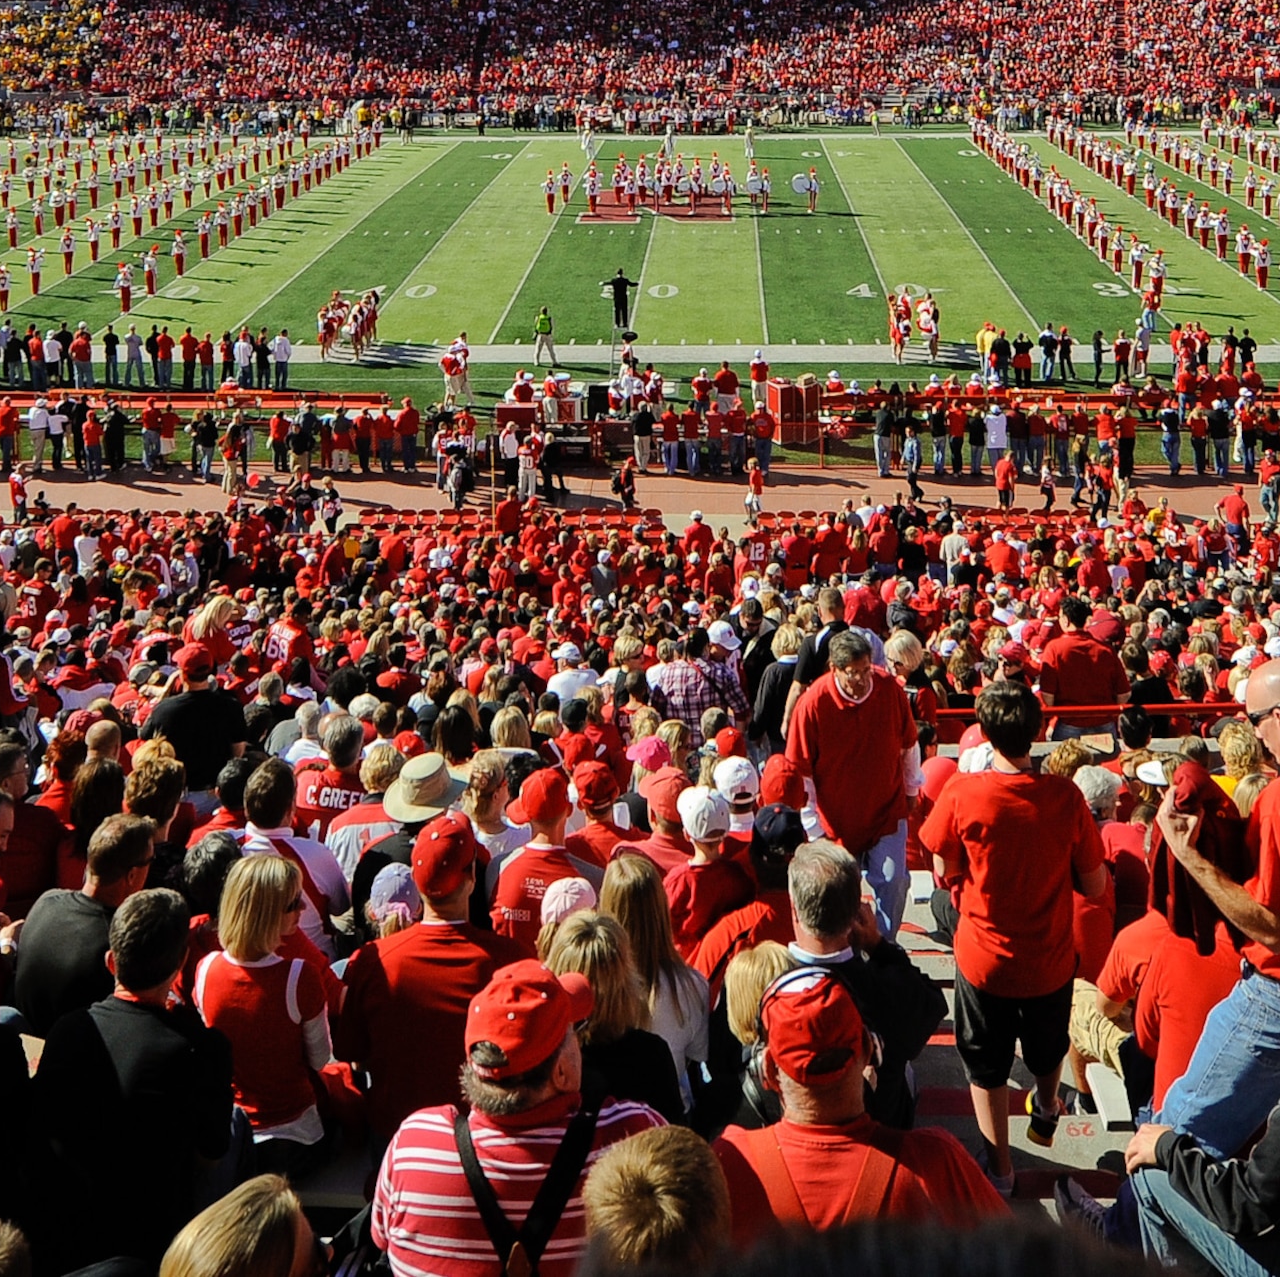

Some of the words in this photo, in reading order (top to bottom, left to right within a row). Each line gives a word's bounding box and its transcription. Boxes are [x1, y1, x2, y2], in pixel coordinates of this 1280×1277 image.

[750, 542, 767, 561] 12
[266, 634, 290, 663] 68
[306, 785, 366, 810] C.GREE
